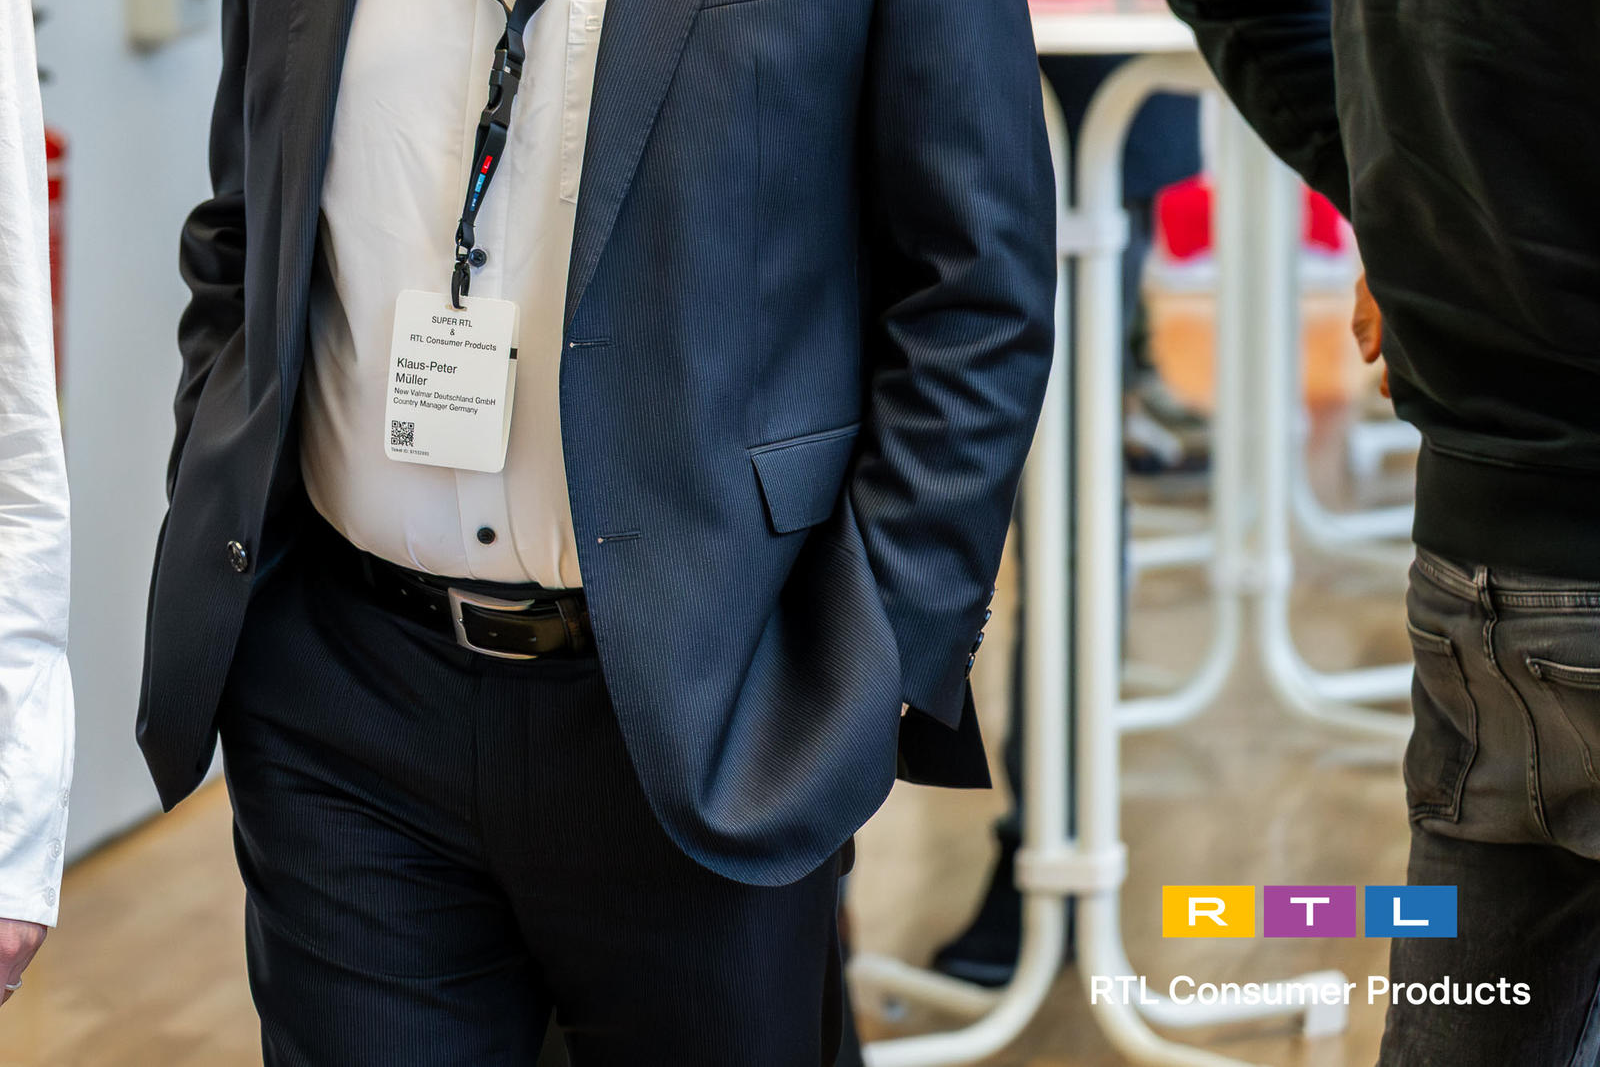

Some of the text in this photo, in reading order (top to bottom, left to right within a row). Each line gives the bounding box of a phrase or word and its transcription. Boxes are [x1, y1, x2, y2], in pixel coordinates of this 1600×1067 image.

[431, 315, 473, 328] SUPER RTL
[410, 334, 497, 352] RTL Consumer Products
[397, 357, 458, 374] Klaus-Peter
[395, 372, 428, 387] Müller
[394, 387, 496, 406] New Valmar Deutschland GmbH
[393, 397, 479, 415] Country Manager Germany
